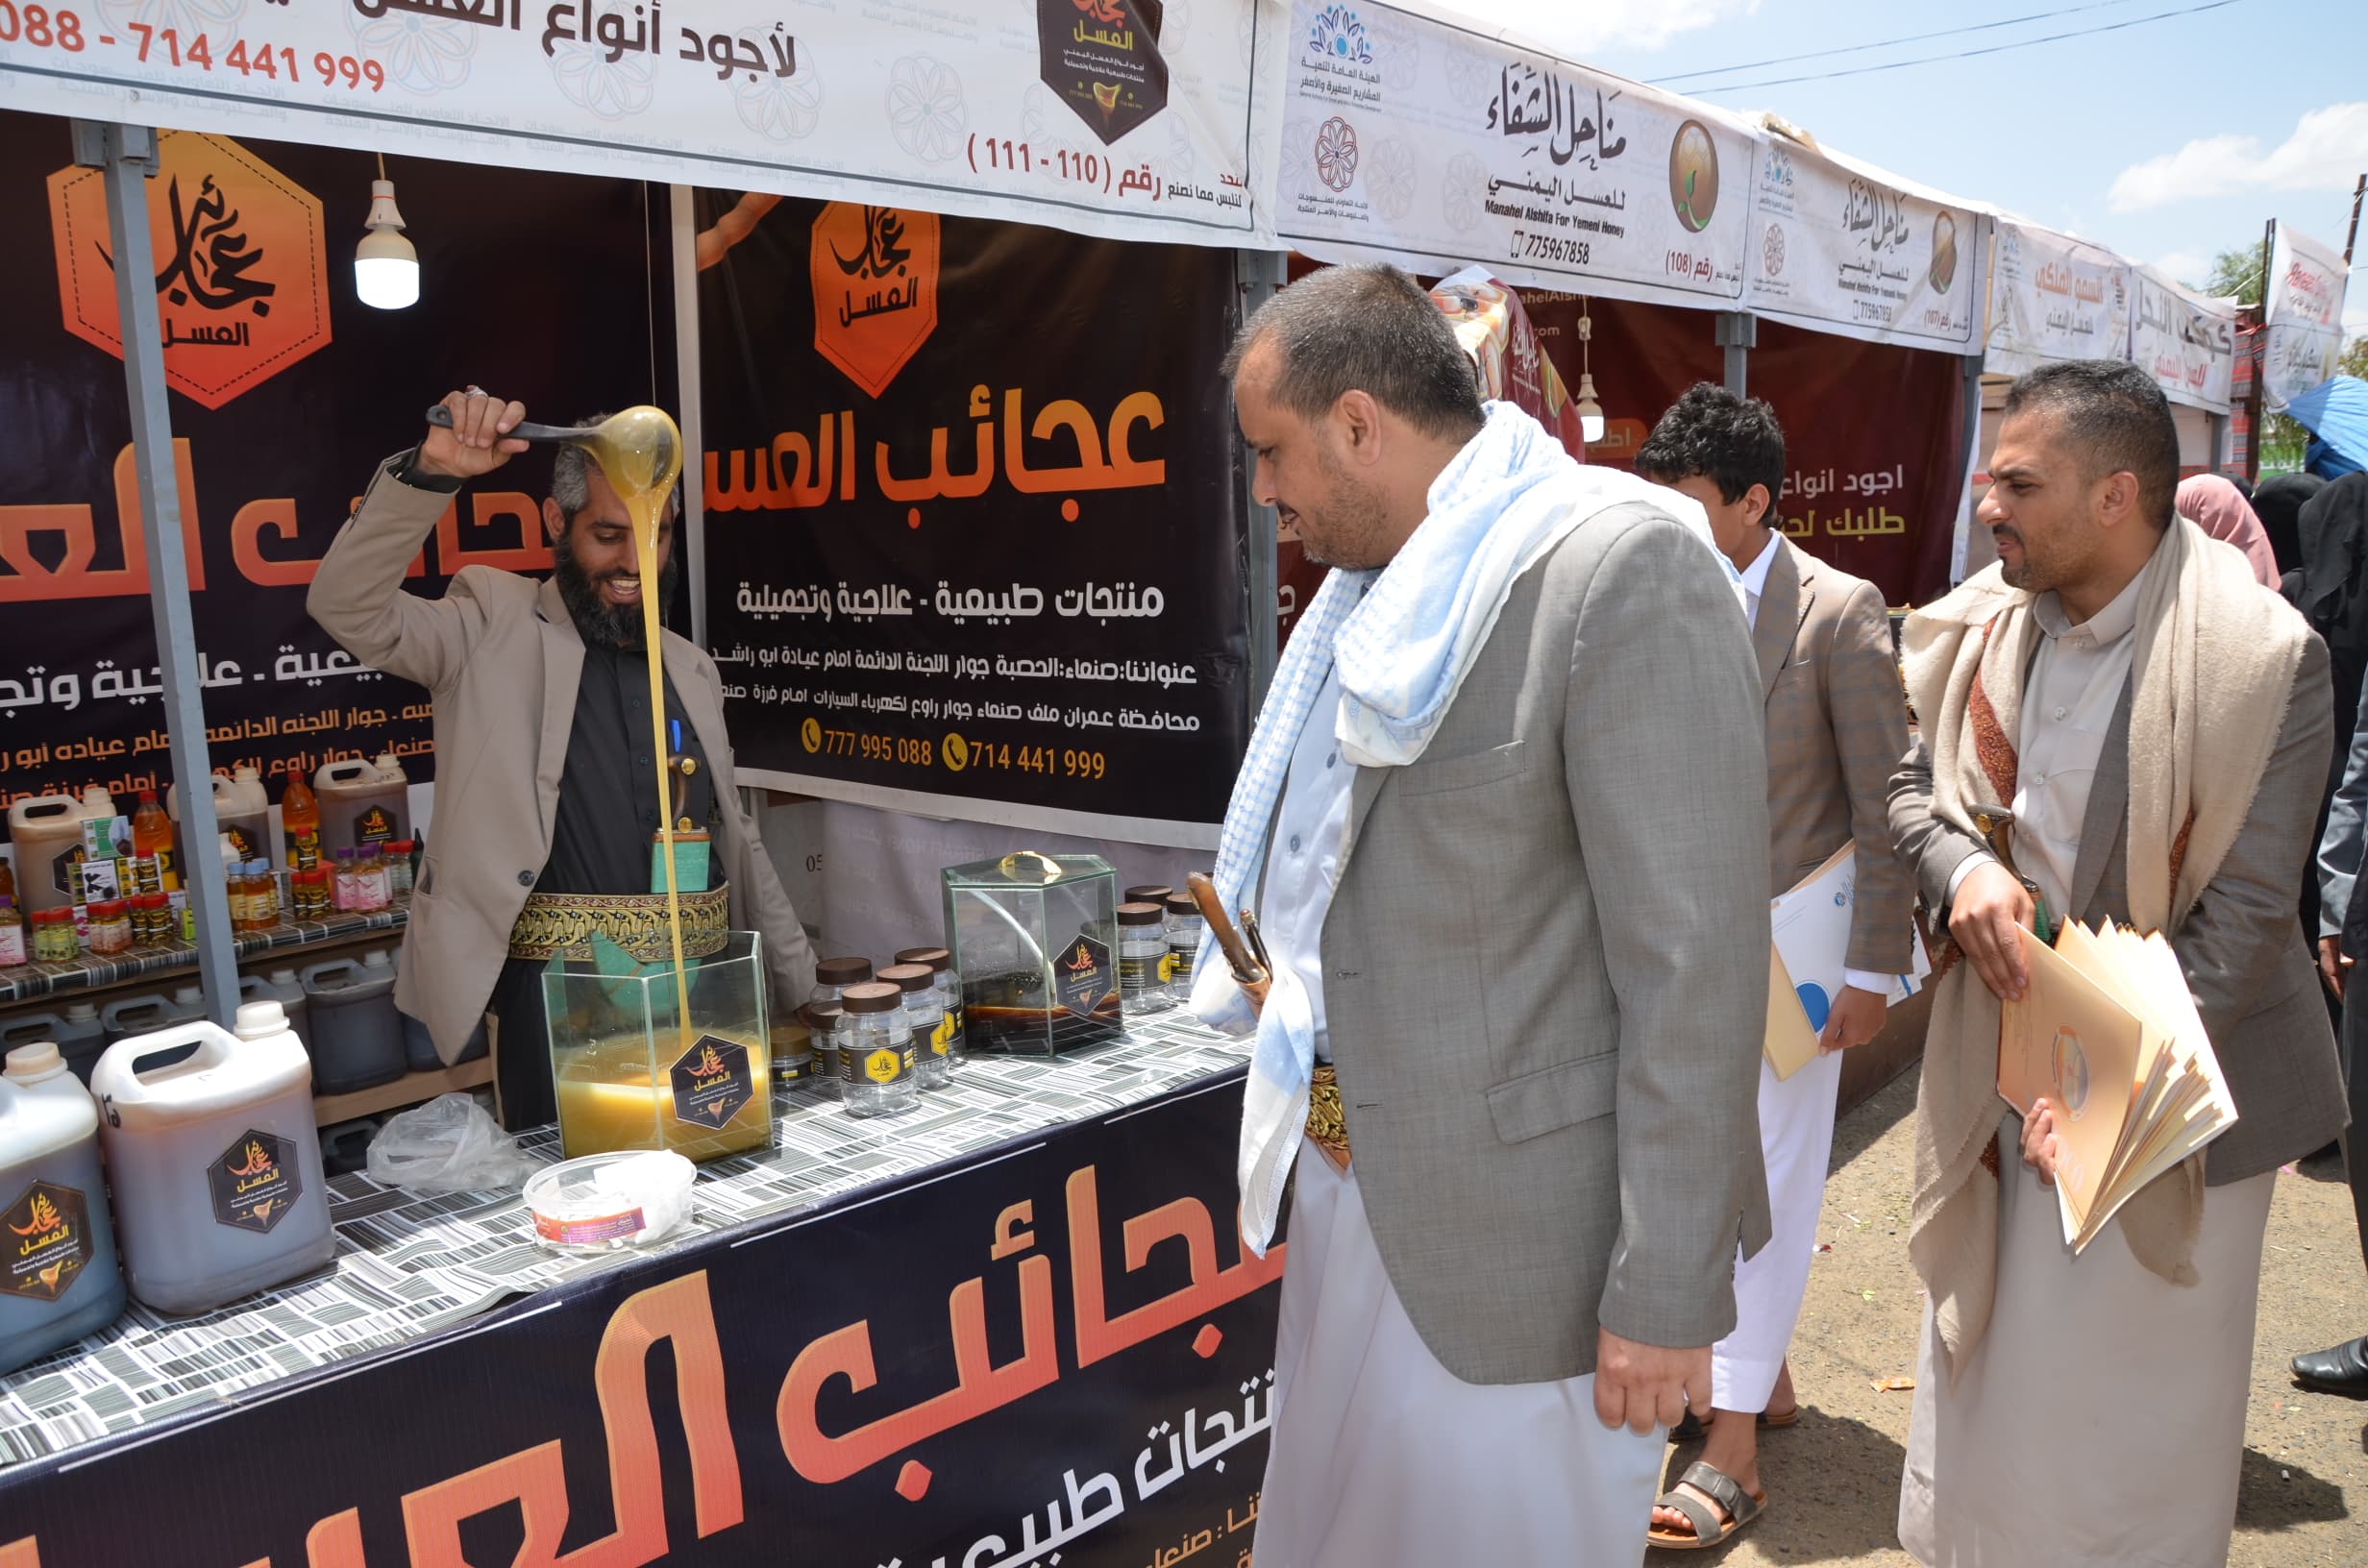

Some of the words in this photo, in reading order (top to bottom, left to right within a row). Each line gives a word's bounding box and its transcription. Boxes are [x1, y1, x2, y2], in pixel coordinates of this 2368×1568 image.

[541, 0, 661, 63] أنواع
[1073, 19, 1133, 51] العسل
[129, 21, 213, 70] 714
[225, 39, 300, 84] 441
[313, 52, 384, 93] 999
[679, 21, 797, 81] لأجود
[1118, 163, 1162, 201] رقم
[1488, 171, 1562, 203] اليمني
[1565, 179, 1626, 210] للعسل
[1485, 199, 1523, 219] Manahel
[1525, 207, 1554, 225] Alshifa
[1555, 212, 1570, 227] For
[1572, 215, 1600, 233] Yemeni
[1601, 220, 1625, 238] Honey
[1525, 233, 1591, 265] 775967858
[1693, 257, 1714, 282] رقم
[839, 277, 919, 329] العسل
[161, 318, 250, 349] العسل
[703, 410, 855, 512] العس
[876, 384, 1166, 529] عجائب
[1843, 464, 1903, 496] اجود
[1826, 506, 1905, 542] طلبك
[737, 581, 832, 623] وتجميلية
[837, 581, 913, 623] علاجية
[935, 580, 1044, 625] طبيعية
[1055, 581, 1165, 626] منتجات
[712, 642, 755, 668] راشد
[759, 647, 778, 669] ابو
[781, 645, 820, 670] عيادة
[824, 650, 851, 672] امام
[855, 649, 902, 671] الدائمة
[906, 651, 950, 677] اللجنة
[953, 655, 990, 680] جوار
[780, 688, 808, 705] امام
[814, 690, 858, 710] السيارات
[861, 693, 907, 714] لكهرباء
[943, 698, 973, 721] جوار
[976, 700, 1023, 721] صنعاء
[282, 708, 340, 736] اللجنه
[345, 706, 387, 731] جوار
[1027, 702, 1060, 723] ملف
[1064, 706, 1114, 730] عمران
[1119, 708, 1200, 731] محافظة
[55, 737, 126, 761] عياده
[825, 729, 856, 756] 777
[861, 733, 893, 762] 995
[898, 737, 933, 766] 088
[970, 741, 1011, 770] 714
[1017, 745, 1055, 774] 441
[1064, 748, 1105, 779] 999
[694, 1070, 731, 1092] العسل
[236, 1168, 279, 1193] العسل
[19, 1224, 69, 1256] العسل
[776, 1164, 1289, 1503] جائب
[1135, 1368, 1274, 1502] نتجات
